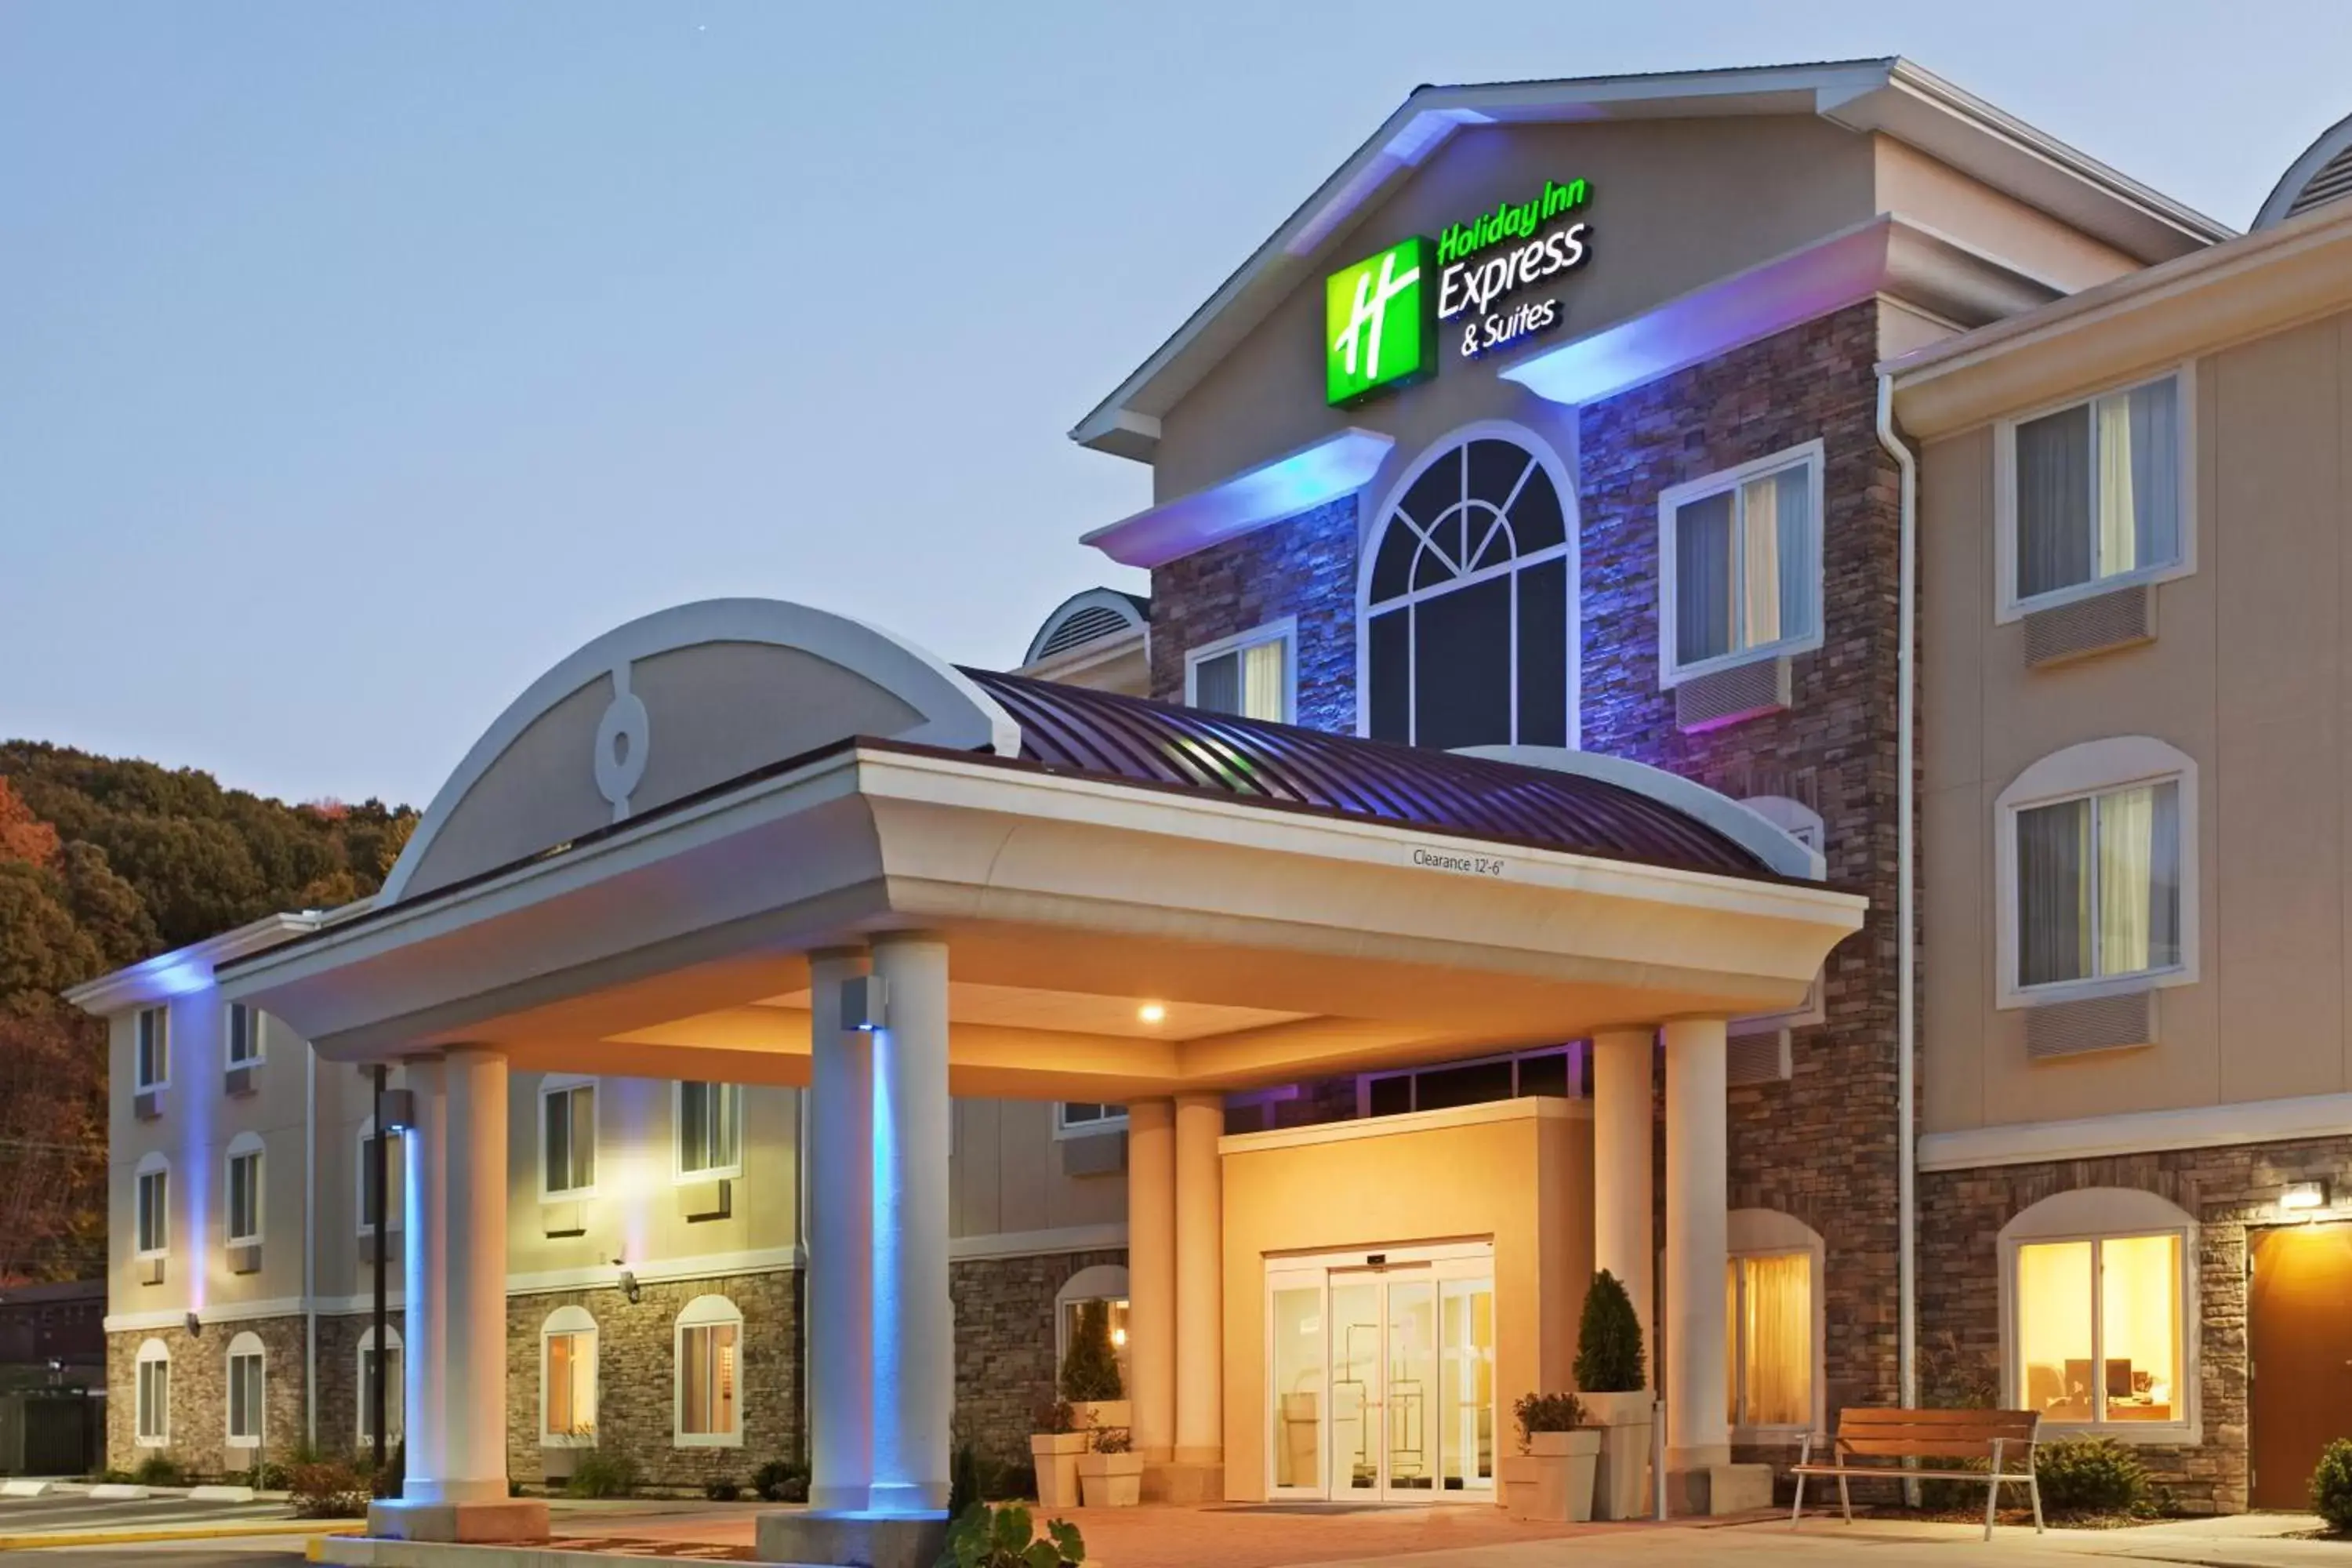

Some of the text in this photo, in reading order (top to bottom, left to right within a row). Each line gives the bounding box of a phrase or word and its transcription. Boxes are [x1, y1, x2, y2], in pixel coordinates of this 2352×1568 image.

[1438, 179, 1585, 266] Holiday Inn
[1438, 223, 1584, 319] Express
[1461, 299, 1555, 356] & Suites
[1414, 849, 1471, 871] Clearance
